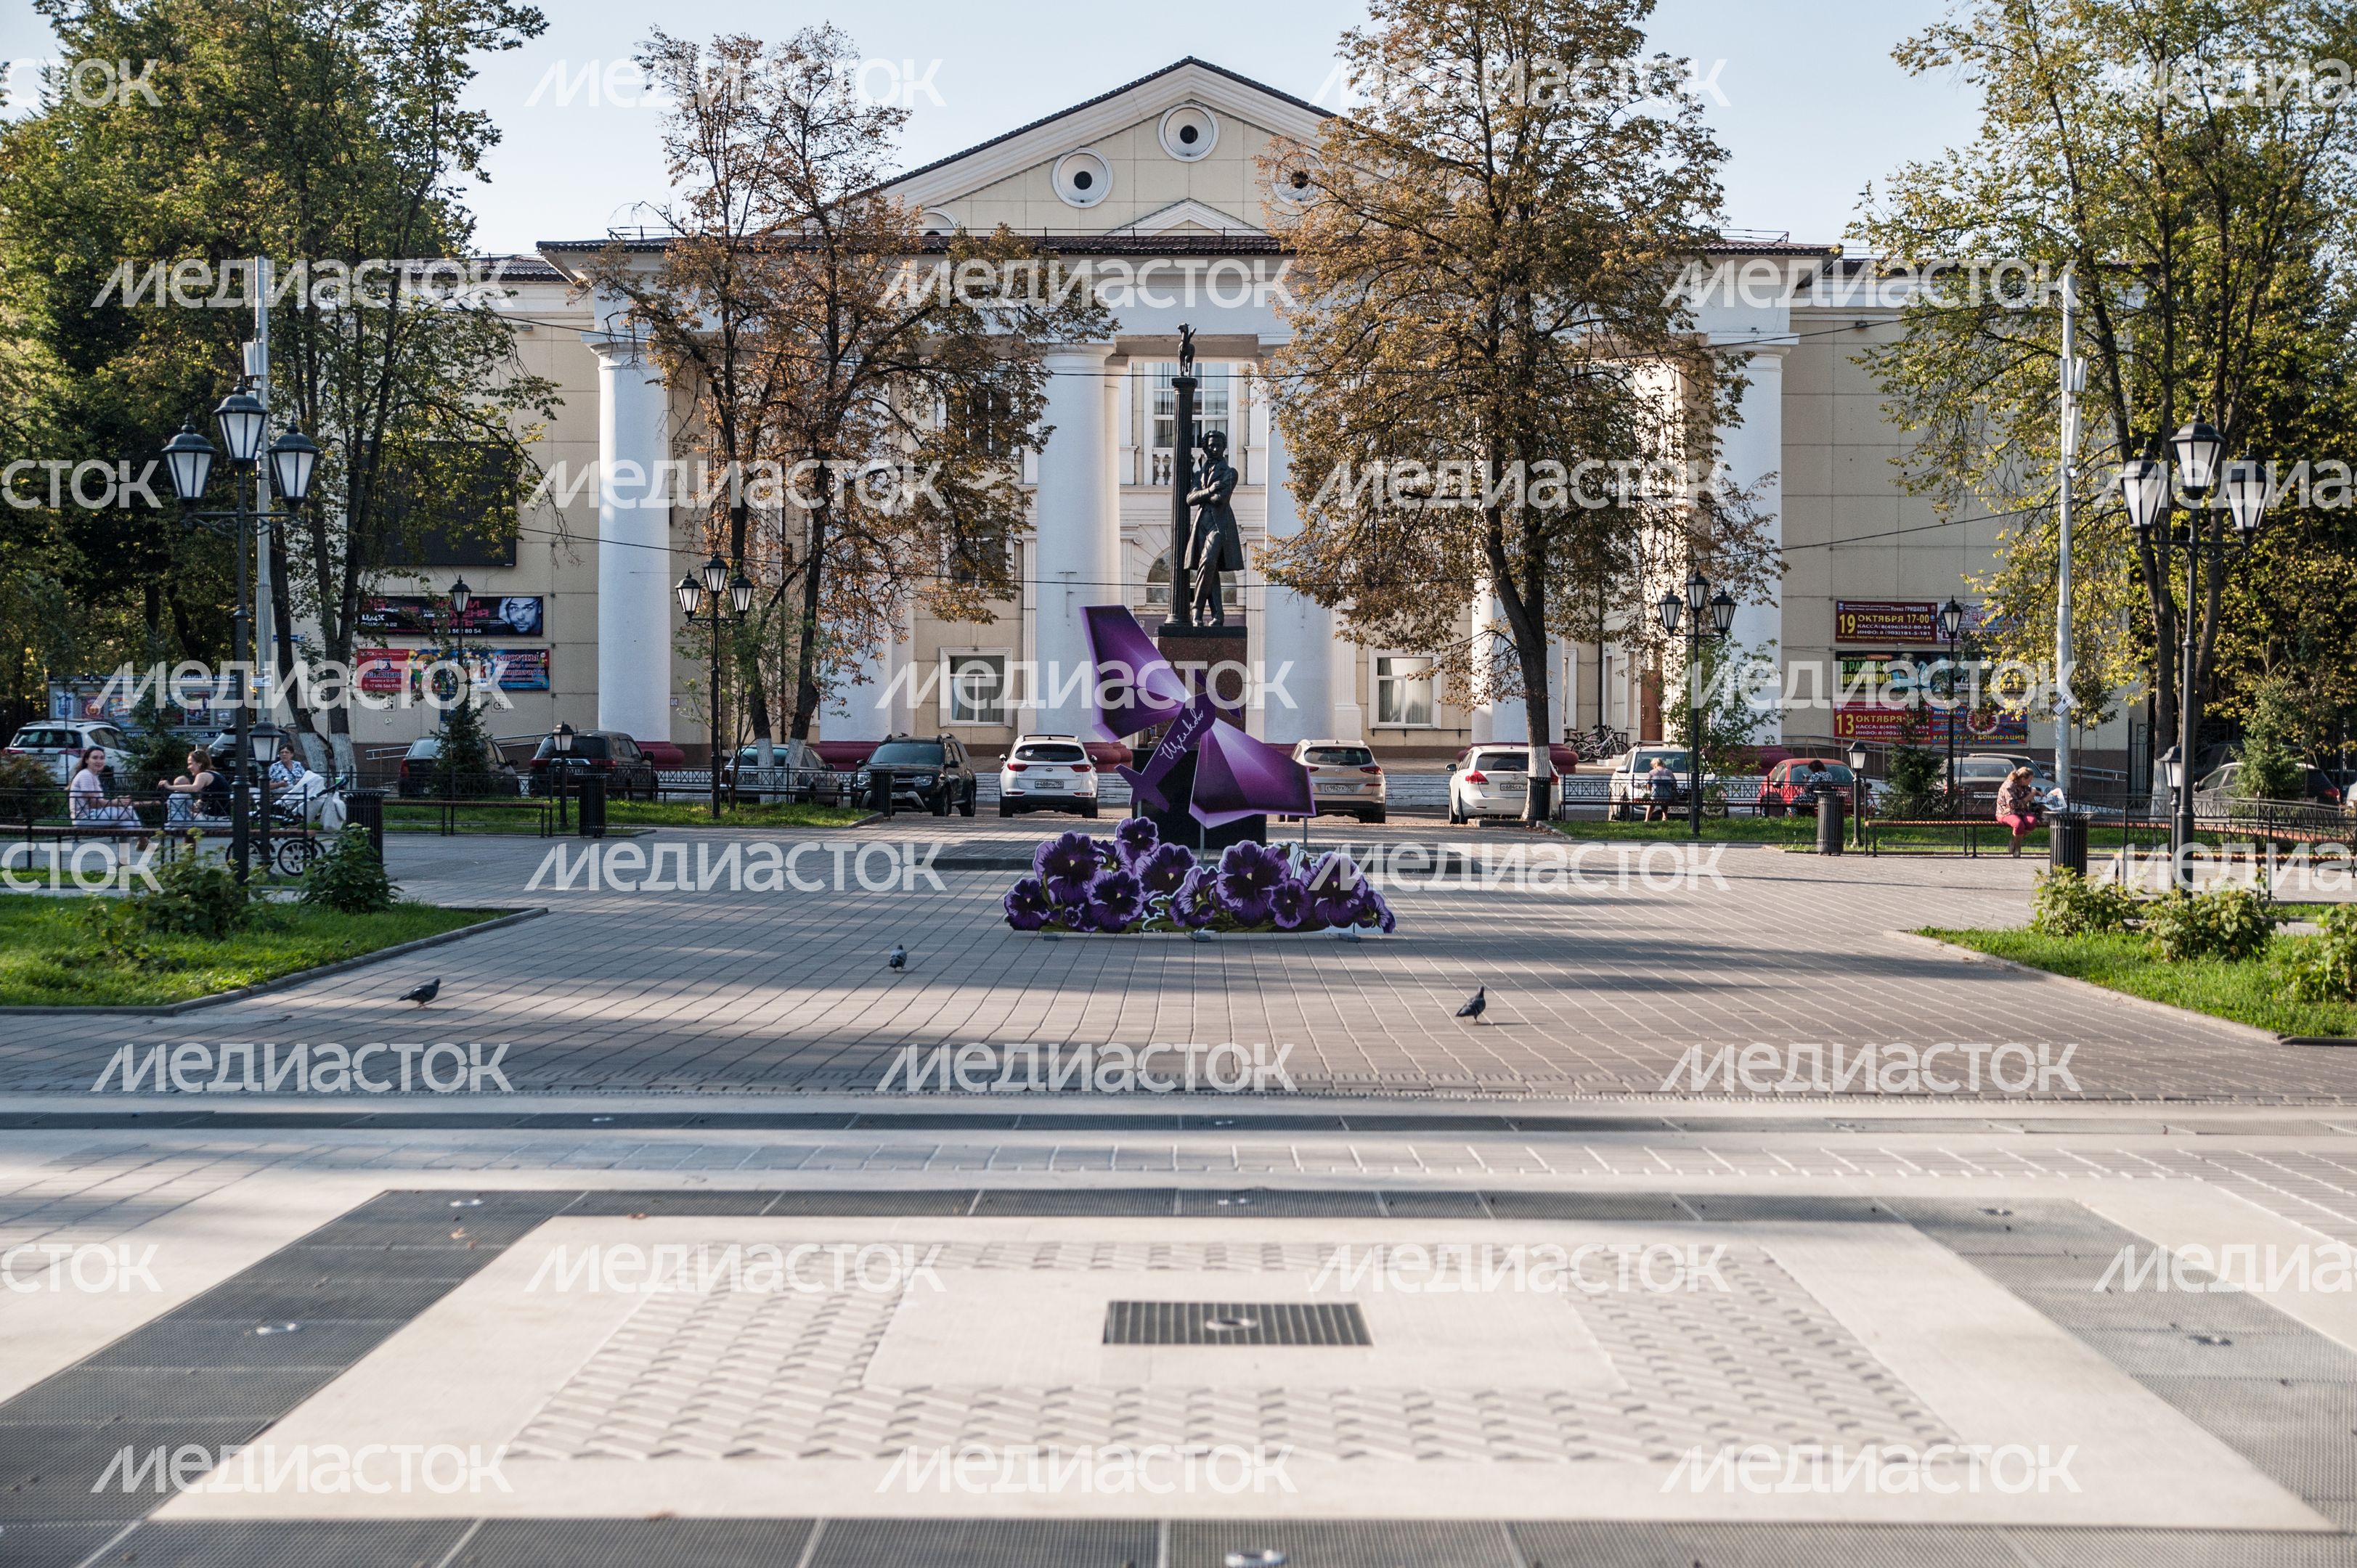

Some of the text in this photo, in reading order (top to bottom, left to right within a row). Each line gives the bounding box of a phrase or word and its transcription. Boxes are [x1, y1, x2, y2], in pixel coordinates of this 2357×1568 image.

[1839, 614, 1929, 634] 19 ОКТЯБРЯ 17-00
[1840, 661, 1889, 671] В РАМКАХ
[1840, 673, 1892, 684] ПРИЛИЧИЯ
[1836, 714, 1854, 735] 13
